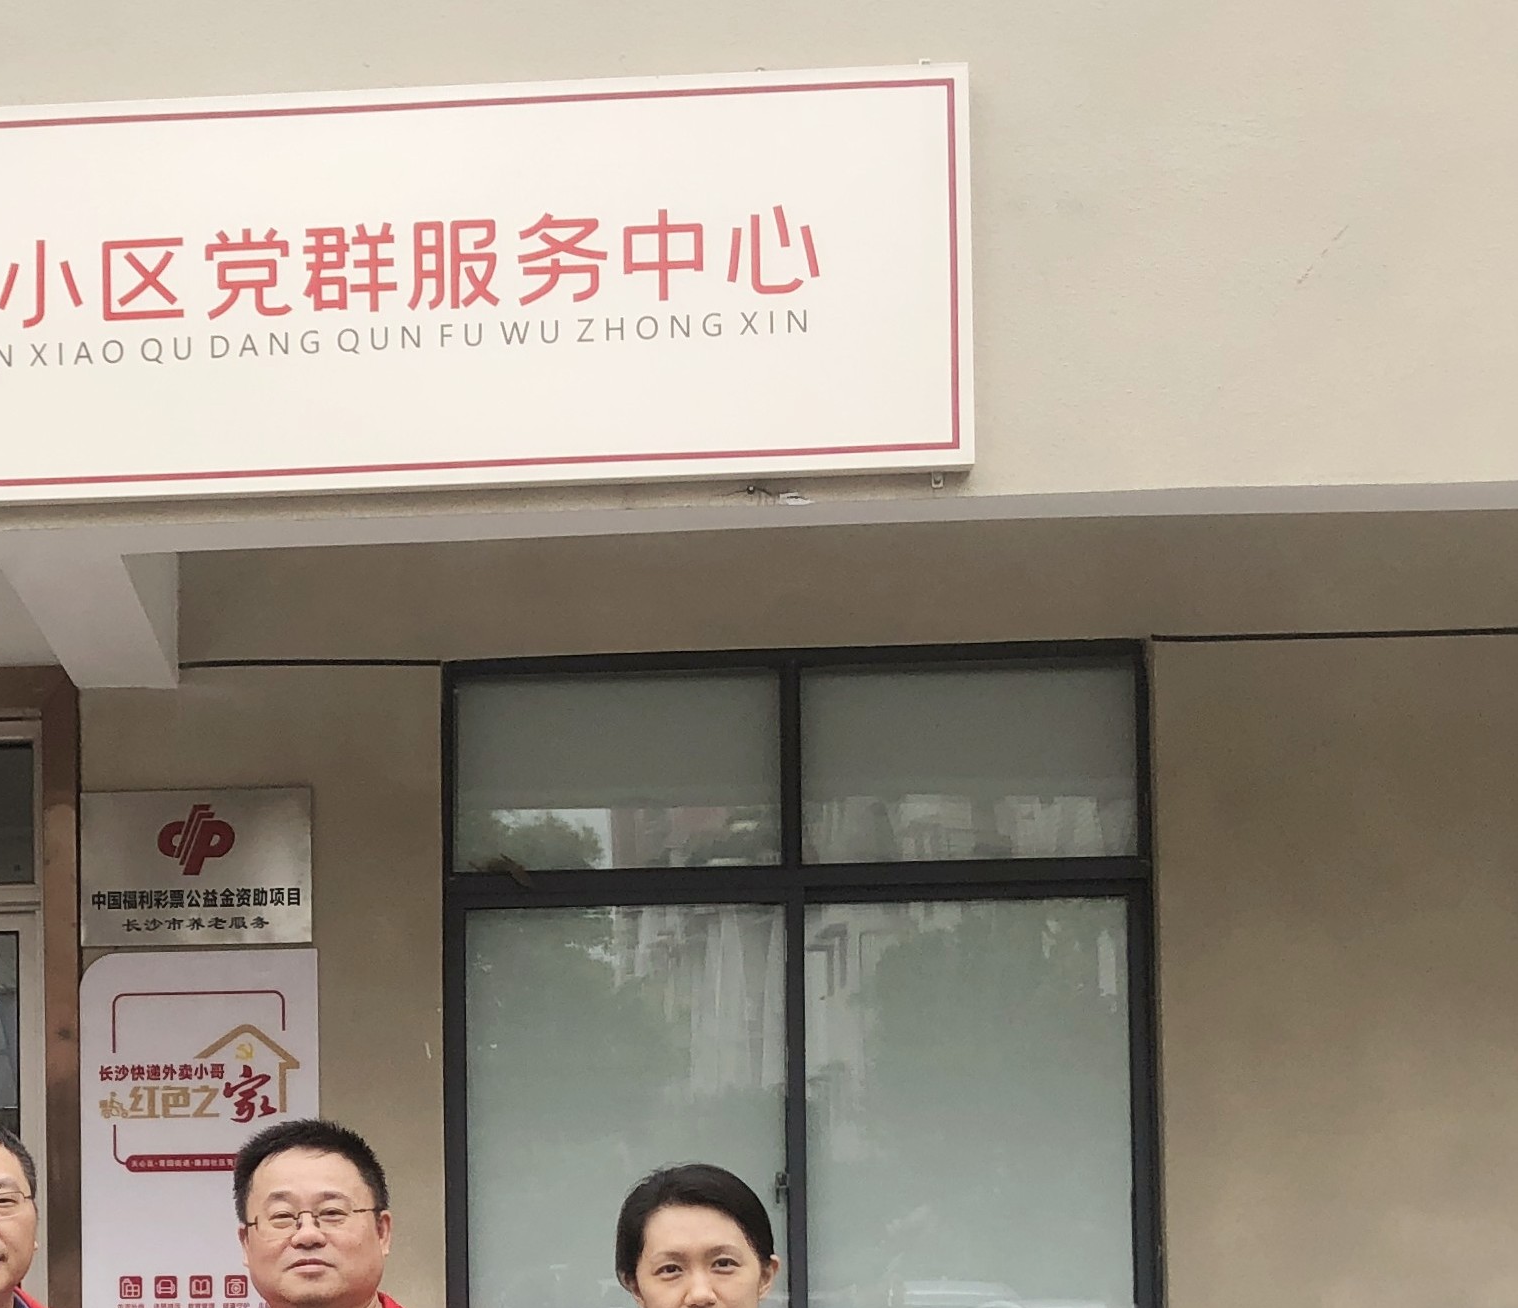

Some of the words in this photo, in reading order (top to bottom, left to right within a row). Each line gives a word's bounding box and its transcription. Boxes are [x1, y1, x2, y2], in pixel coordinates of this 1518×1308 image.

[31, 340, 124, 367] XIAO
[141, 337, 192, 364] QU
[211, 331, 320, 358] DANG
[337, 326, 420, 353] QUN
[440, 324, 482, 348] FU
[500, 320, 559, 345] WU
[577, 313, 722, 342] ZHONG
[740, 309, 808, 335] XIN
[91, 887, 301, 911] 中国福利彩票公益金资助项目
[121, 916, 270, 933] 长沙市养老服务
[98, 1063, 225, 1082] 长沙快递外卖小哥
[128, 1064, 278, 1124] 红色之家
